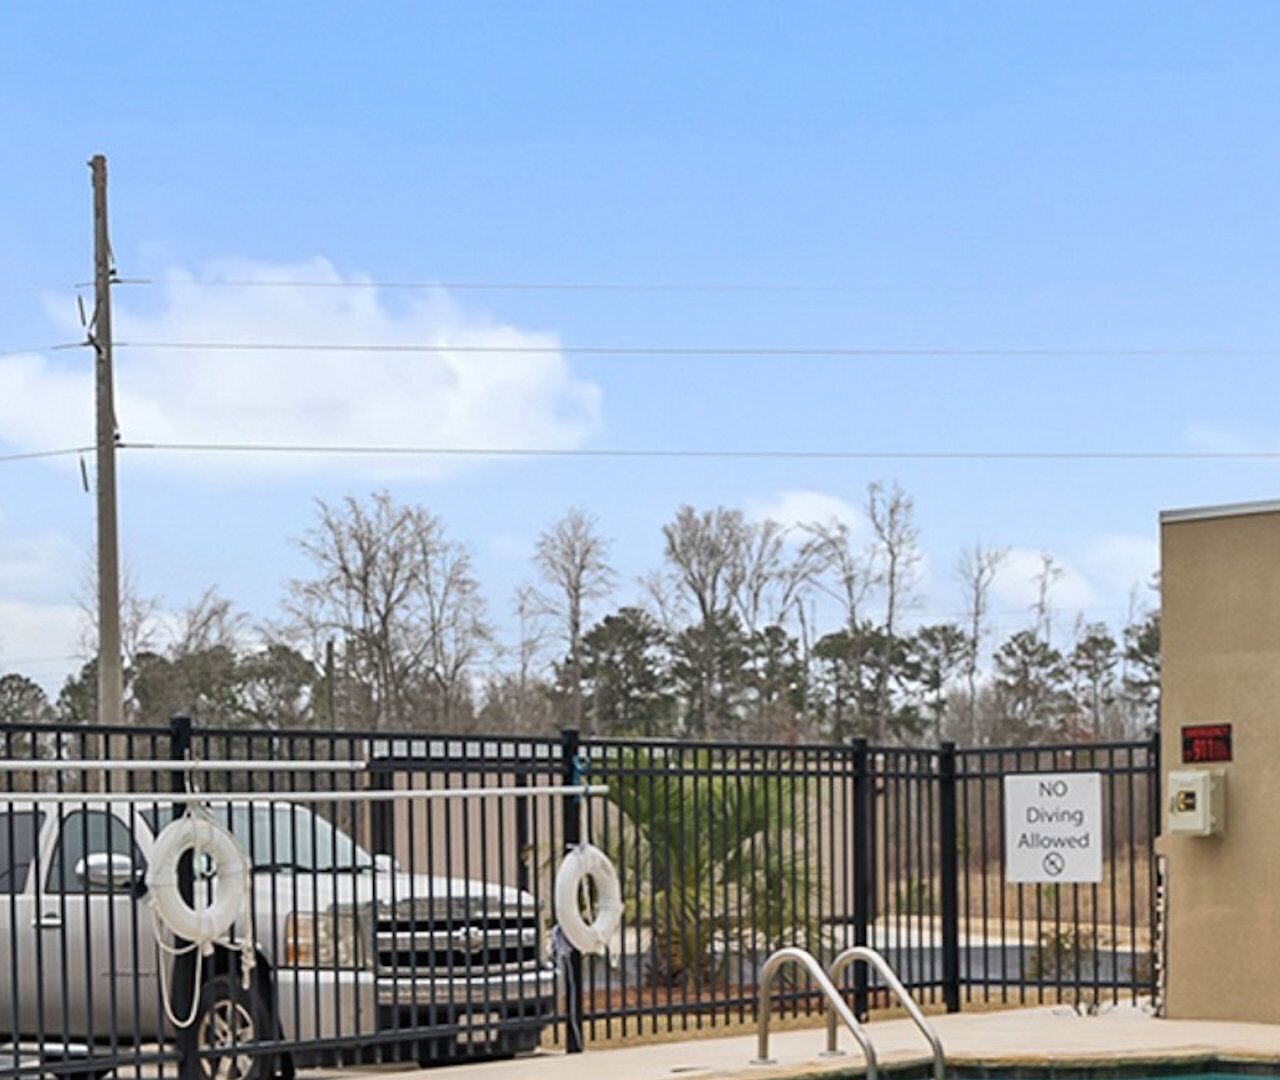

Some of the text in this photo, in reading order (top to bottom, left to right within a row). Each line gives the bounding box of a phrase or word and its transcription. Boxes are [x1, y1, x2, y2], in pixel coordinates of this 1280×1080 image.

[1038, 780, 1068, 798] NO
[1025, 806, 1085, 827] Diving
[1017, 832, 1090, 850] Allowed
